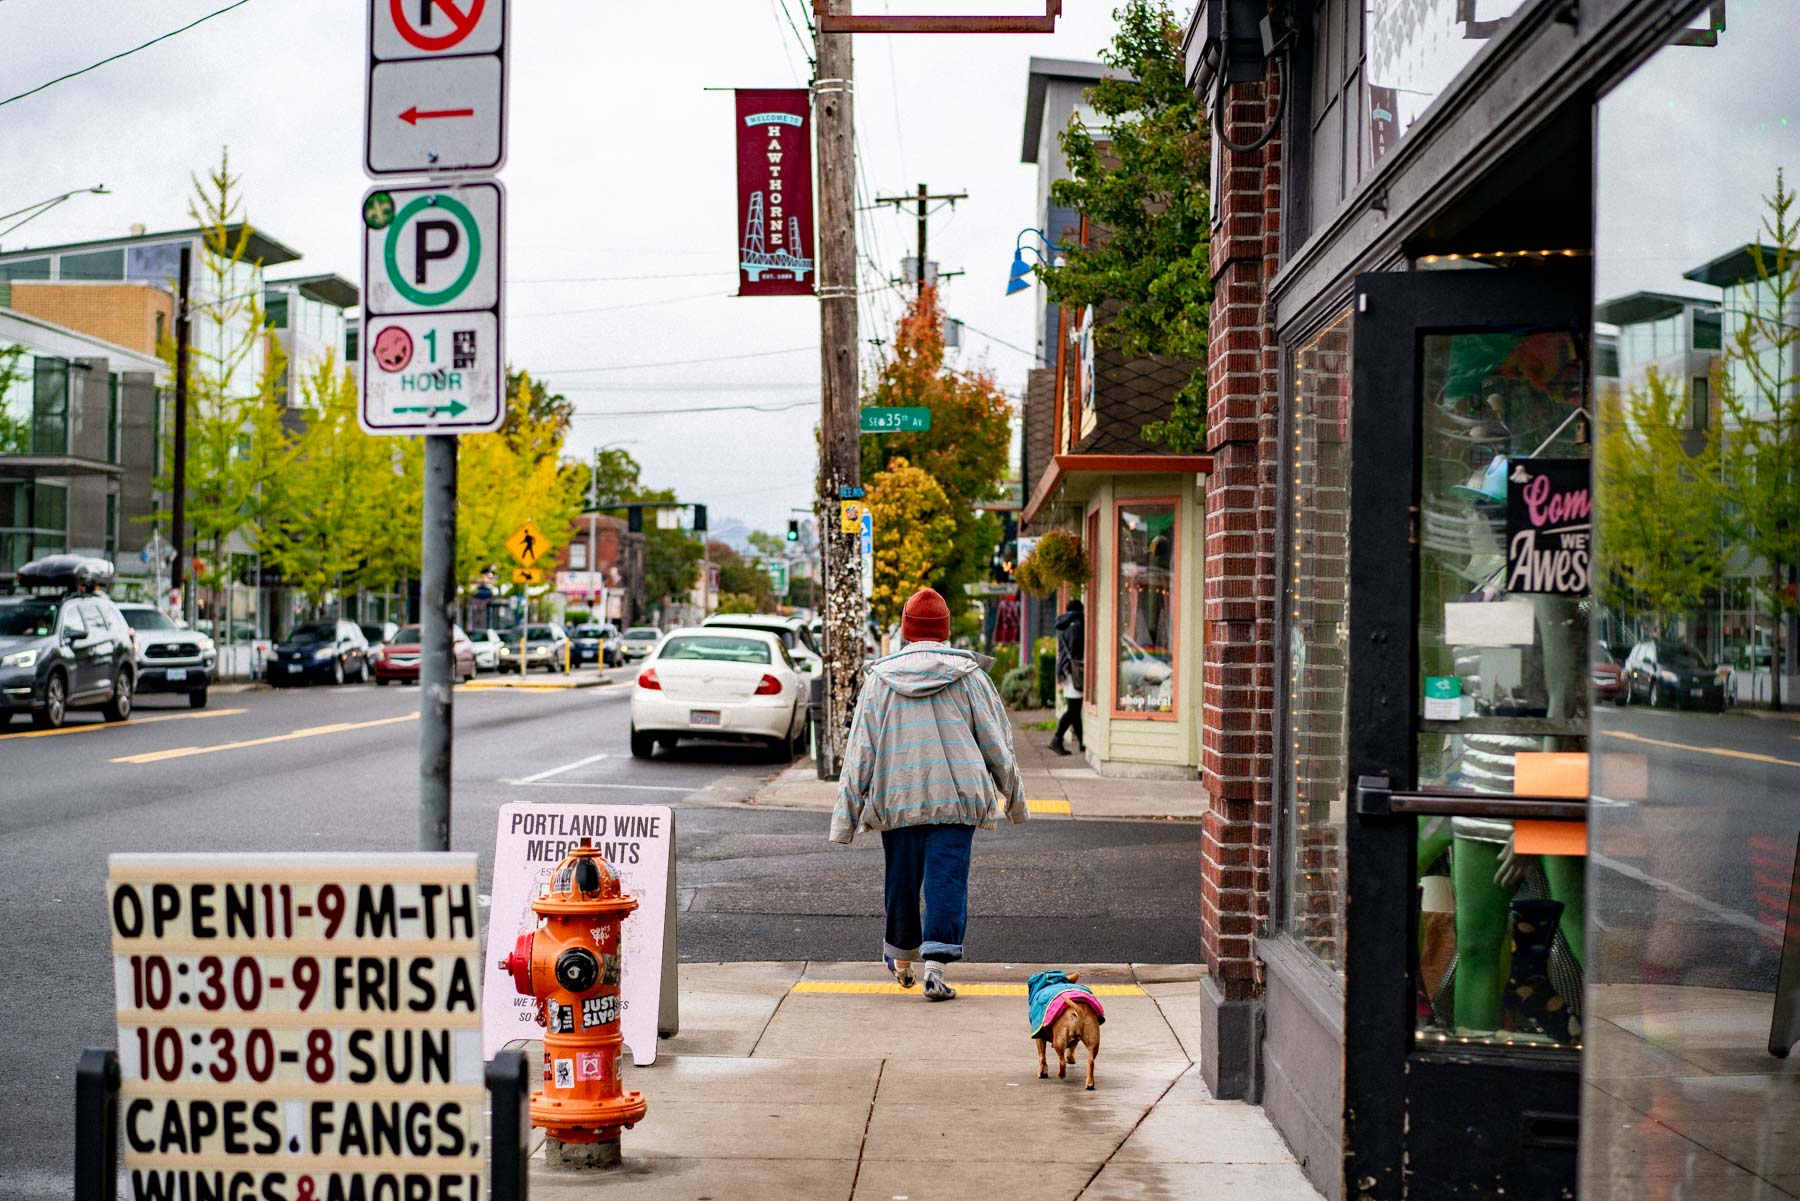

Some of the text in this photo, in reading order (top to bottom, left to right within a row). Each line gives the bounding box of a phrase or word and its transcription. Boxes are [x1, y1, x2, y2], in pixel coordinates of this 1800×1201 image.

[750, 114, 789, 123] WELCOME
[766, 126, 783, 244] HAWTHORNE
[415, 220, 460, 284] P
[423, 328, 437, 363] 1
[402, 371, 463, 392] HOUR
[869, 417, 879, 426] SE
[1522, 474, 1592, 527] Com
[511, 813, 661, 838] PORTLAND WINE
[113, 883, 475, 939] OPEN 11-9 M-TH
[130, 955, 321, 1012] 10:30-9
[514, 998, 528, 1006] WE
[519, 1012, 531, 1021] SO
[583, 995, 614, 1013] JUST
[136, 1026, 451, 1084] 10:30-8 SUN
[131, 1169, 288, 1201] WINGS
